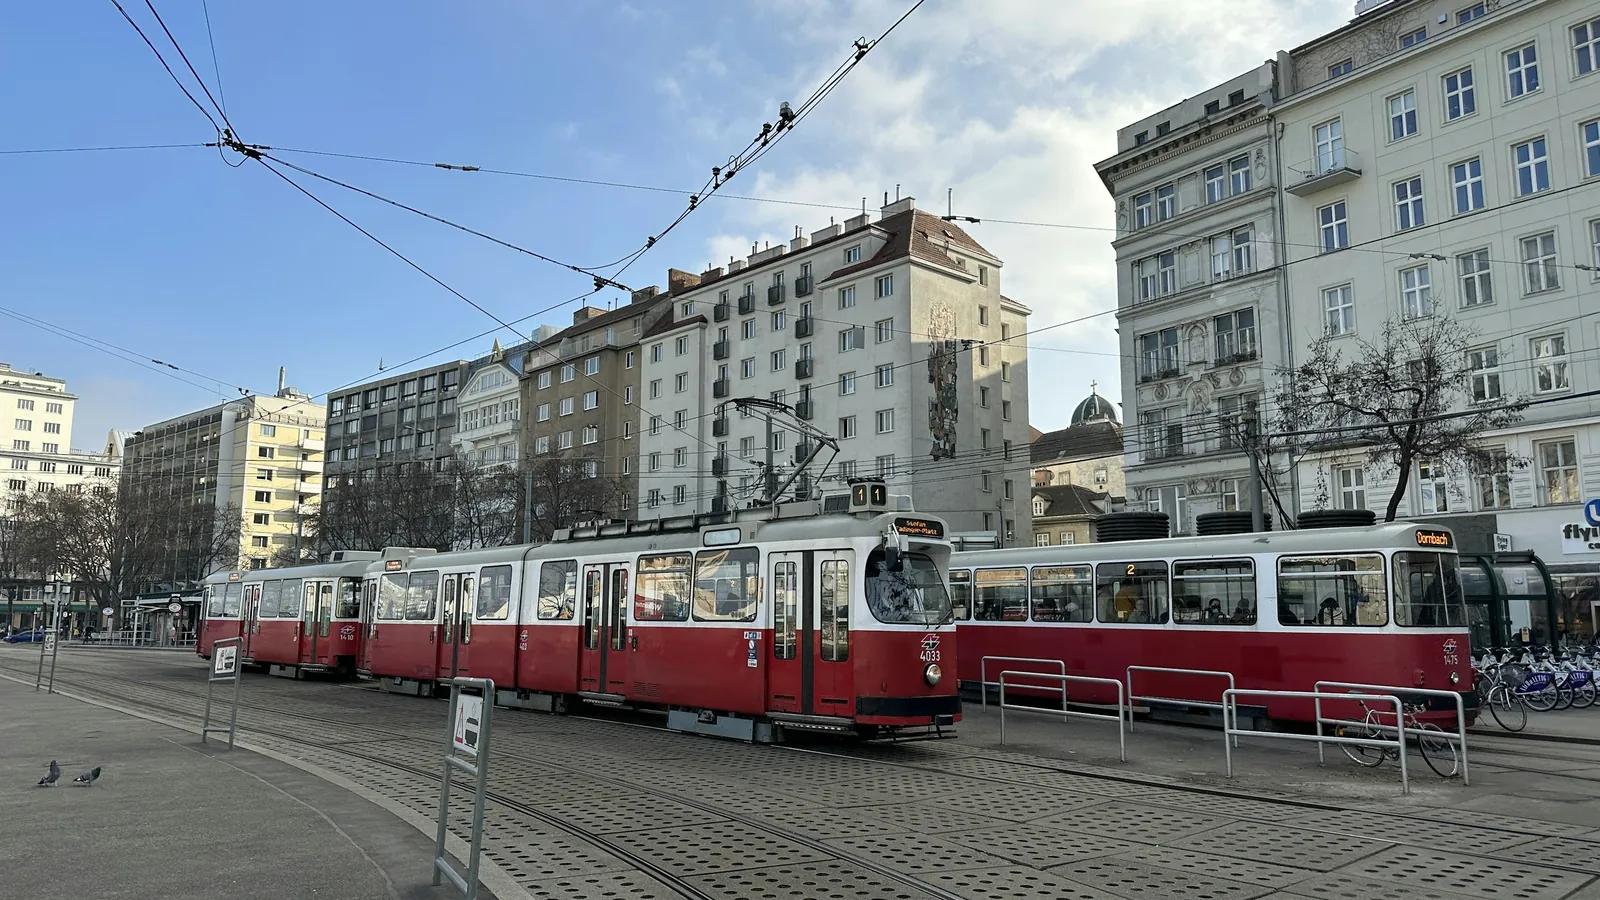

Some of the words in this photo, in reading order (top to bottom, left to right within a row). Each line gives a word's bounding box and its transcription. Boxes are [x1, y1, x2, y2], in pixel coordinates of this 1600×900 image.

[858, 488, 863, 501] 1
[874, 488, 880, 501] 1
[1416, 531, 1448, 545] Dornbach
[1562, 524, 1600, 542] flyi
[1127, 564, 1135, 575] 2
[920, 650, 941, 662] 4033
[1443, 654, 1458, 665] 1475
